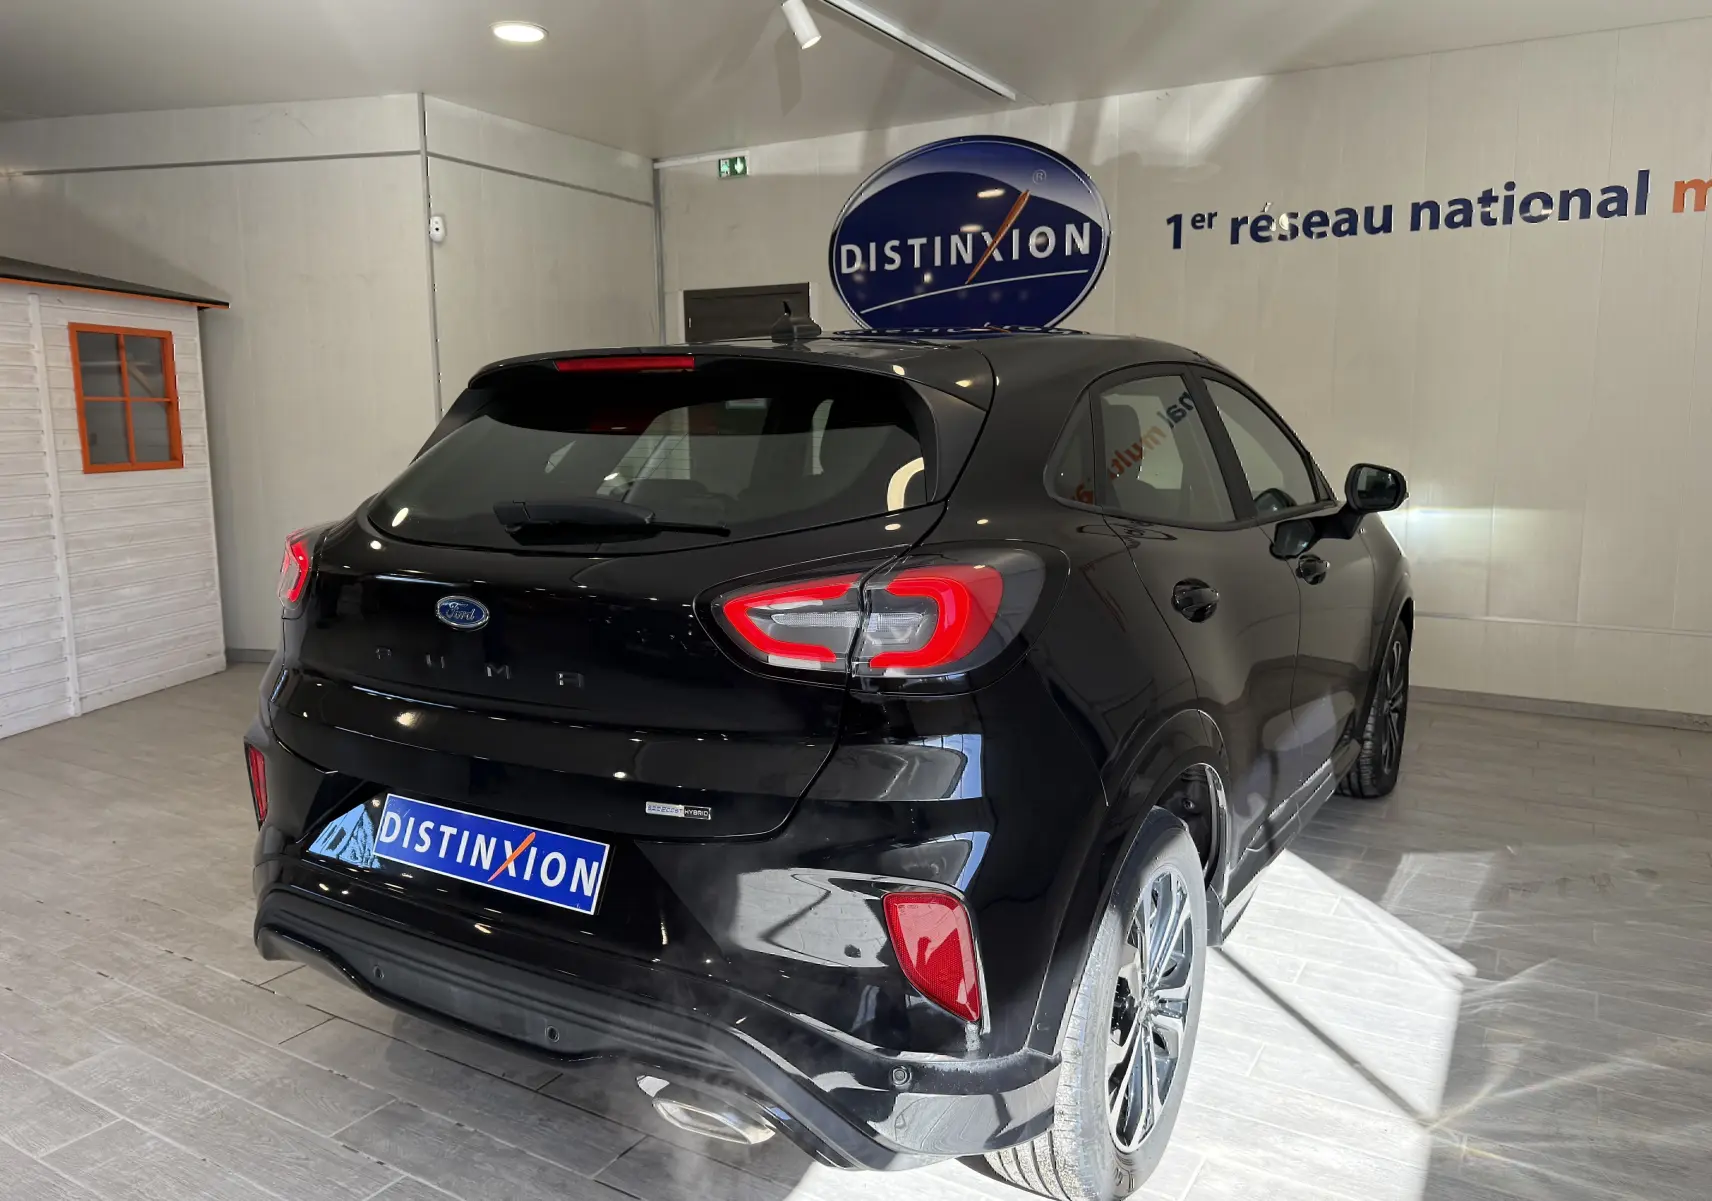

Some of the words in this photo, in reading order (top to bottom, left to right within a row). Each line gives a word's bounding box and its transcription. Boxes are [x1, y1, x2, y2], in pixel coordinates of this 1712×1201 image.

[840, 189, 1092, 285] DISTINXION
[1166, 211, 1218, 250] 1er
[1230, 202, 1394, 245] réseau
[1410, 168, 1650, 232] national
[441, 601, 476, 622] Ford
[379, 811, 600, 897] DISTINXION
[684, 809, 709, 817] HYBRID
